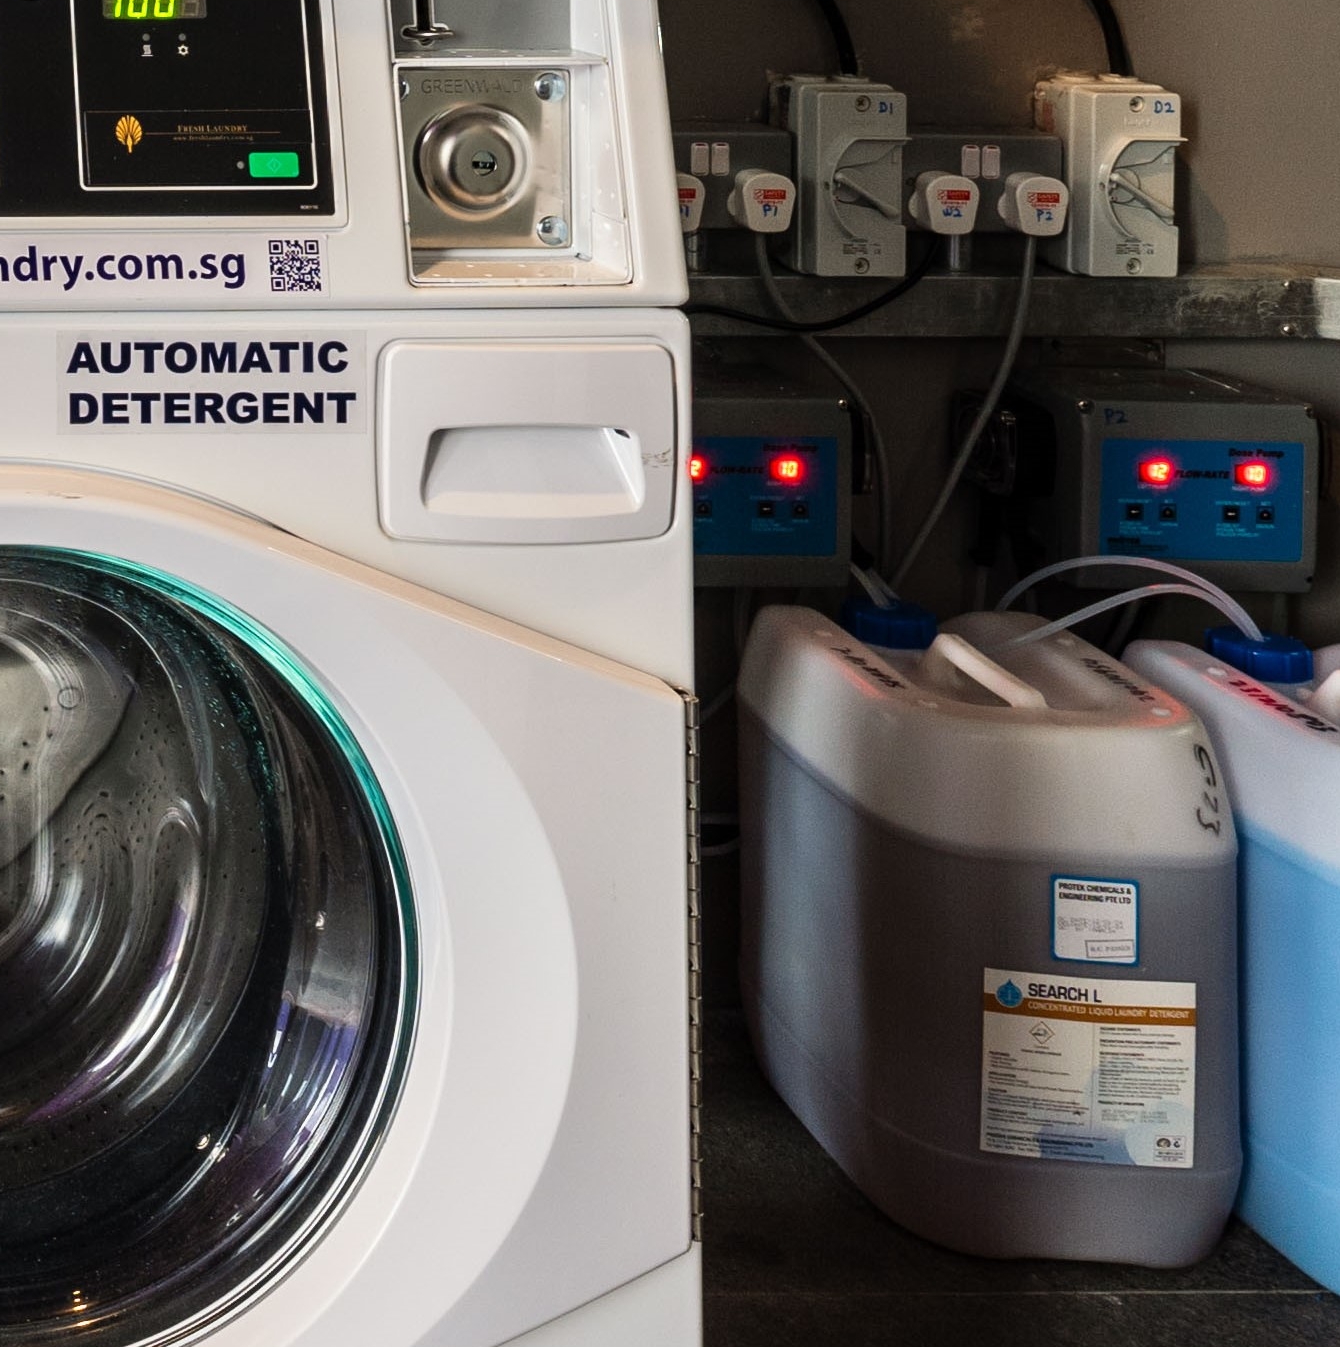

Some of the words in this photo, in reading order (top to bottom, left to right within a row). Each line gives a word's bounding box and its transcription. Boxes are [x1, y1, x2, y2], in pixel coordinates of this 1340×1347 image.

[421, 79, 522, 96] GREENWALD
[1154, 101, 1175, 113] D2
[1036, 209, 1053, 221] P2
[67, 341, 348, 373] AUTOMATIC
[70, 392, 356, 424] DETERGENT
[1028, 983, 1088, 1002] SEARCH
[1094, 990, 1102, 1003] L
[1028, 1002, 1086, 1015] CONCENTRATED
[1089, 1006, 1113, 1016] LIQUID
[1114, 1007, 1147, 1017] LAUNDRY
[1149, 1009, 1190, 1019] DETERGENT
